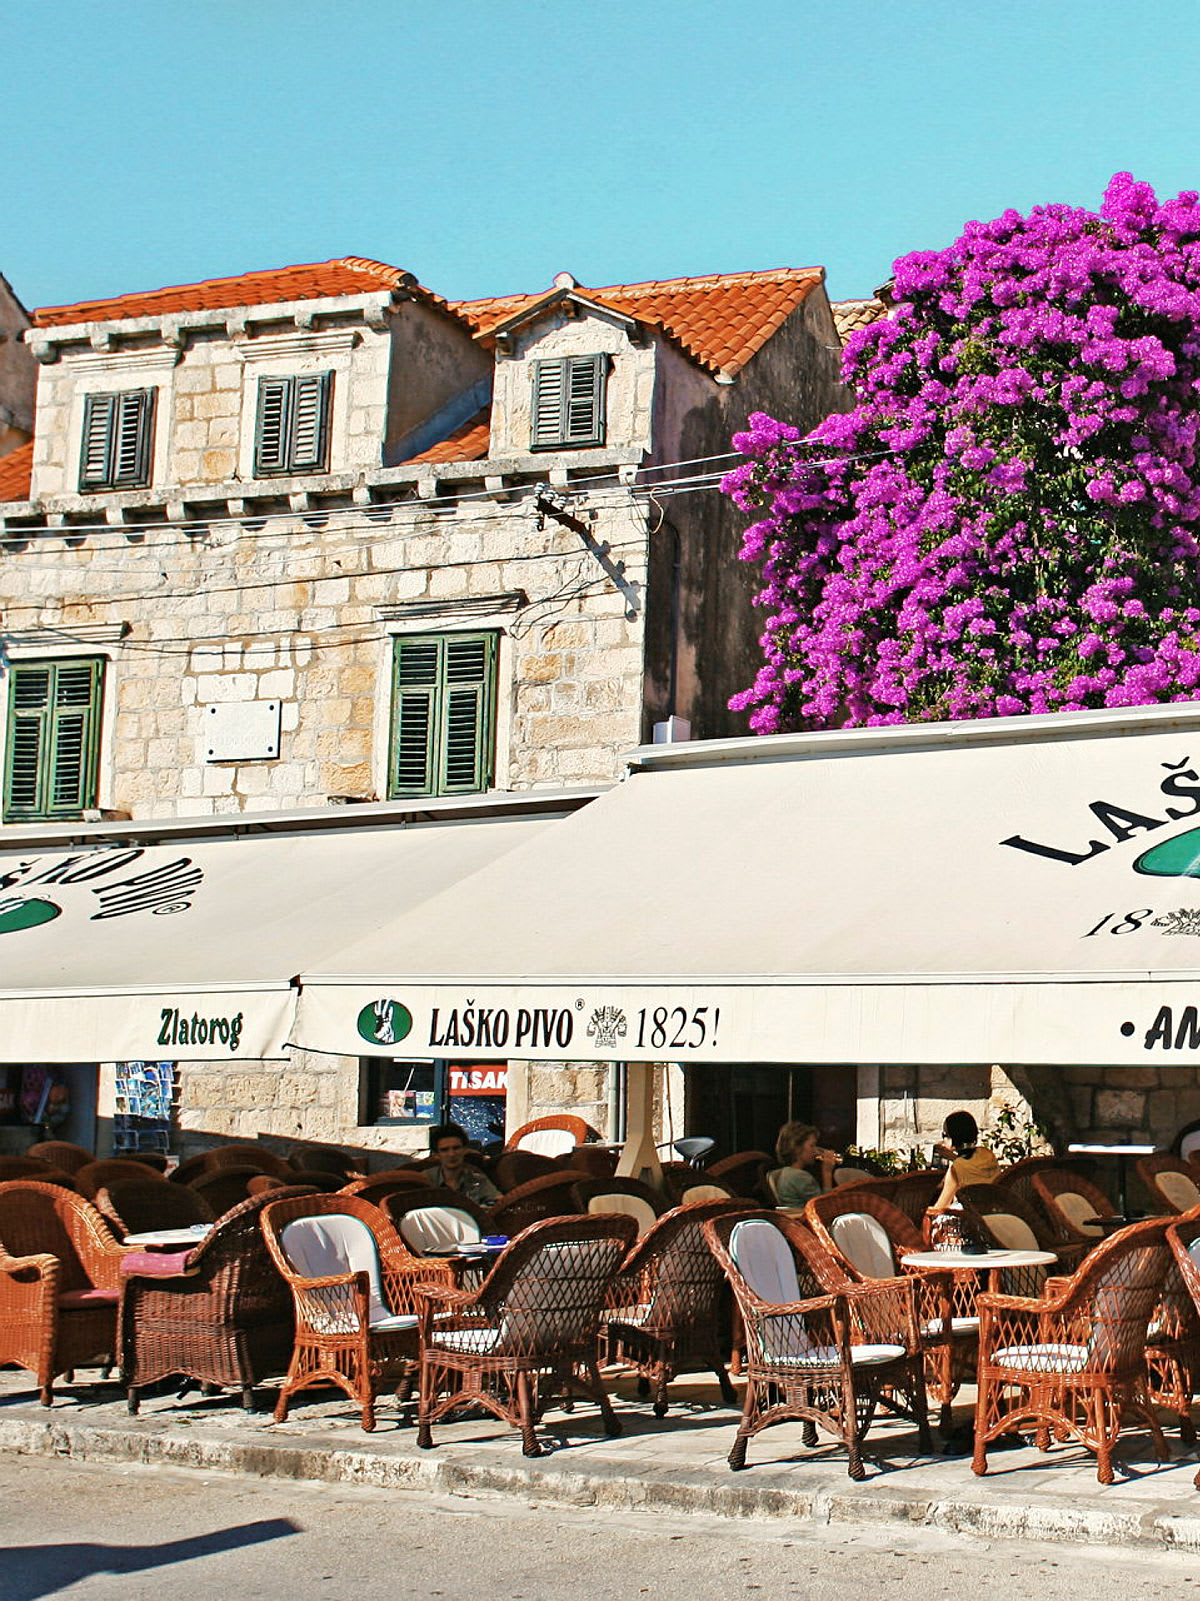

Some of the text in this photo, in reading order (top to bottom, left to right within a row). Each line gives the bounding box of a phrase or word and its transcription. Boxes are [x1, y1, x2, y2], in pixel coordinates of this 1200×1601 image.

[157, 1007, 244, 1052] Zlatorog
[428, 998, 510, 1048] LAŠKO
[514, 1007, 574, 1048] PIVO
[634, 1005, 721, 1049] 1825!
[450, 1070, 509, 1090] TISAK
